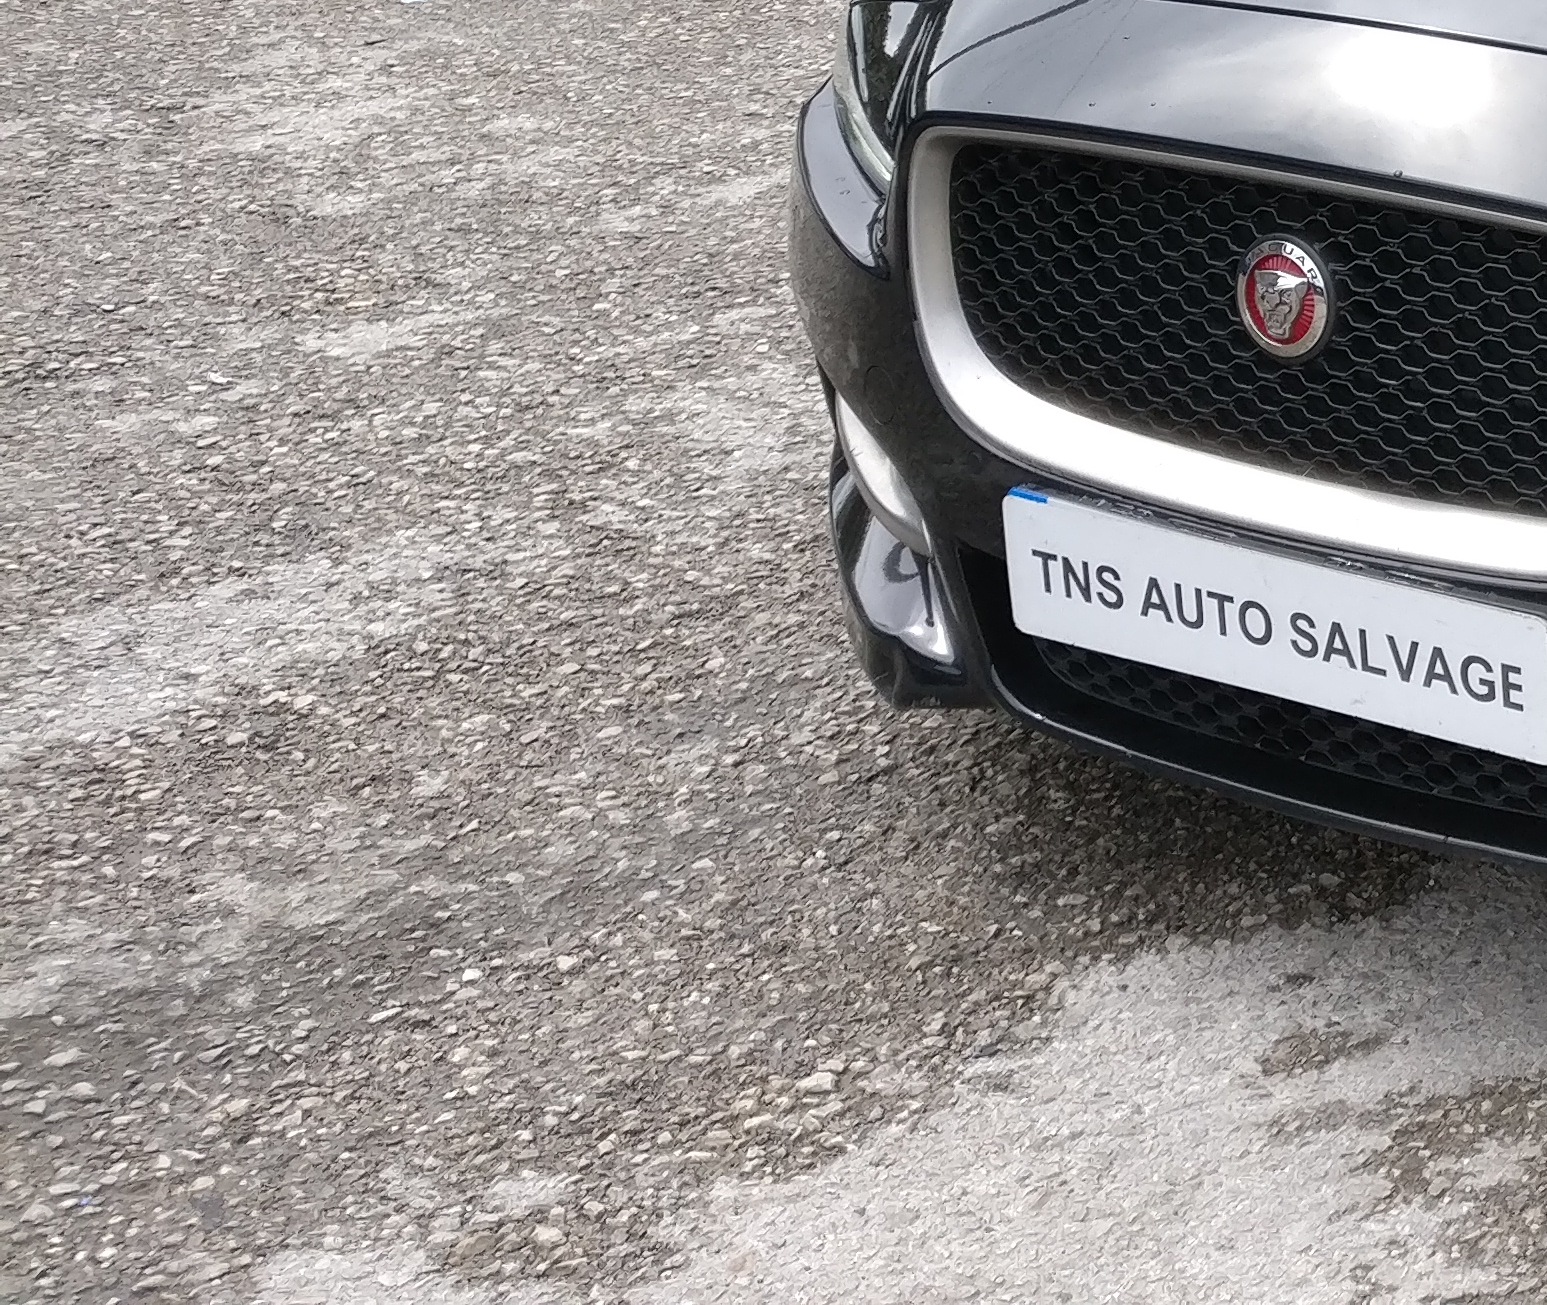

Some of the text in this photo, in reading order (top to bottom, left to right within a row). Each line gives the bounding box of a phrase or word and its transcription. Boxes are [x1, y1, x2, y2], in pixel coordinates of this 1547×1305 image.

[1031, 549, 1524, 712] TNS AUTO SALVAGE
